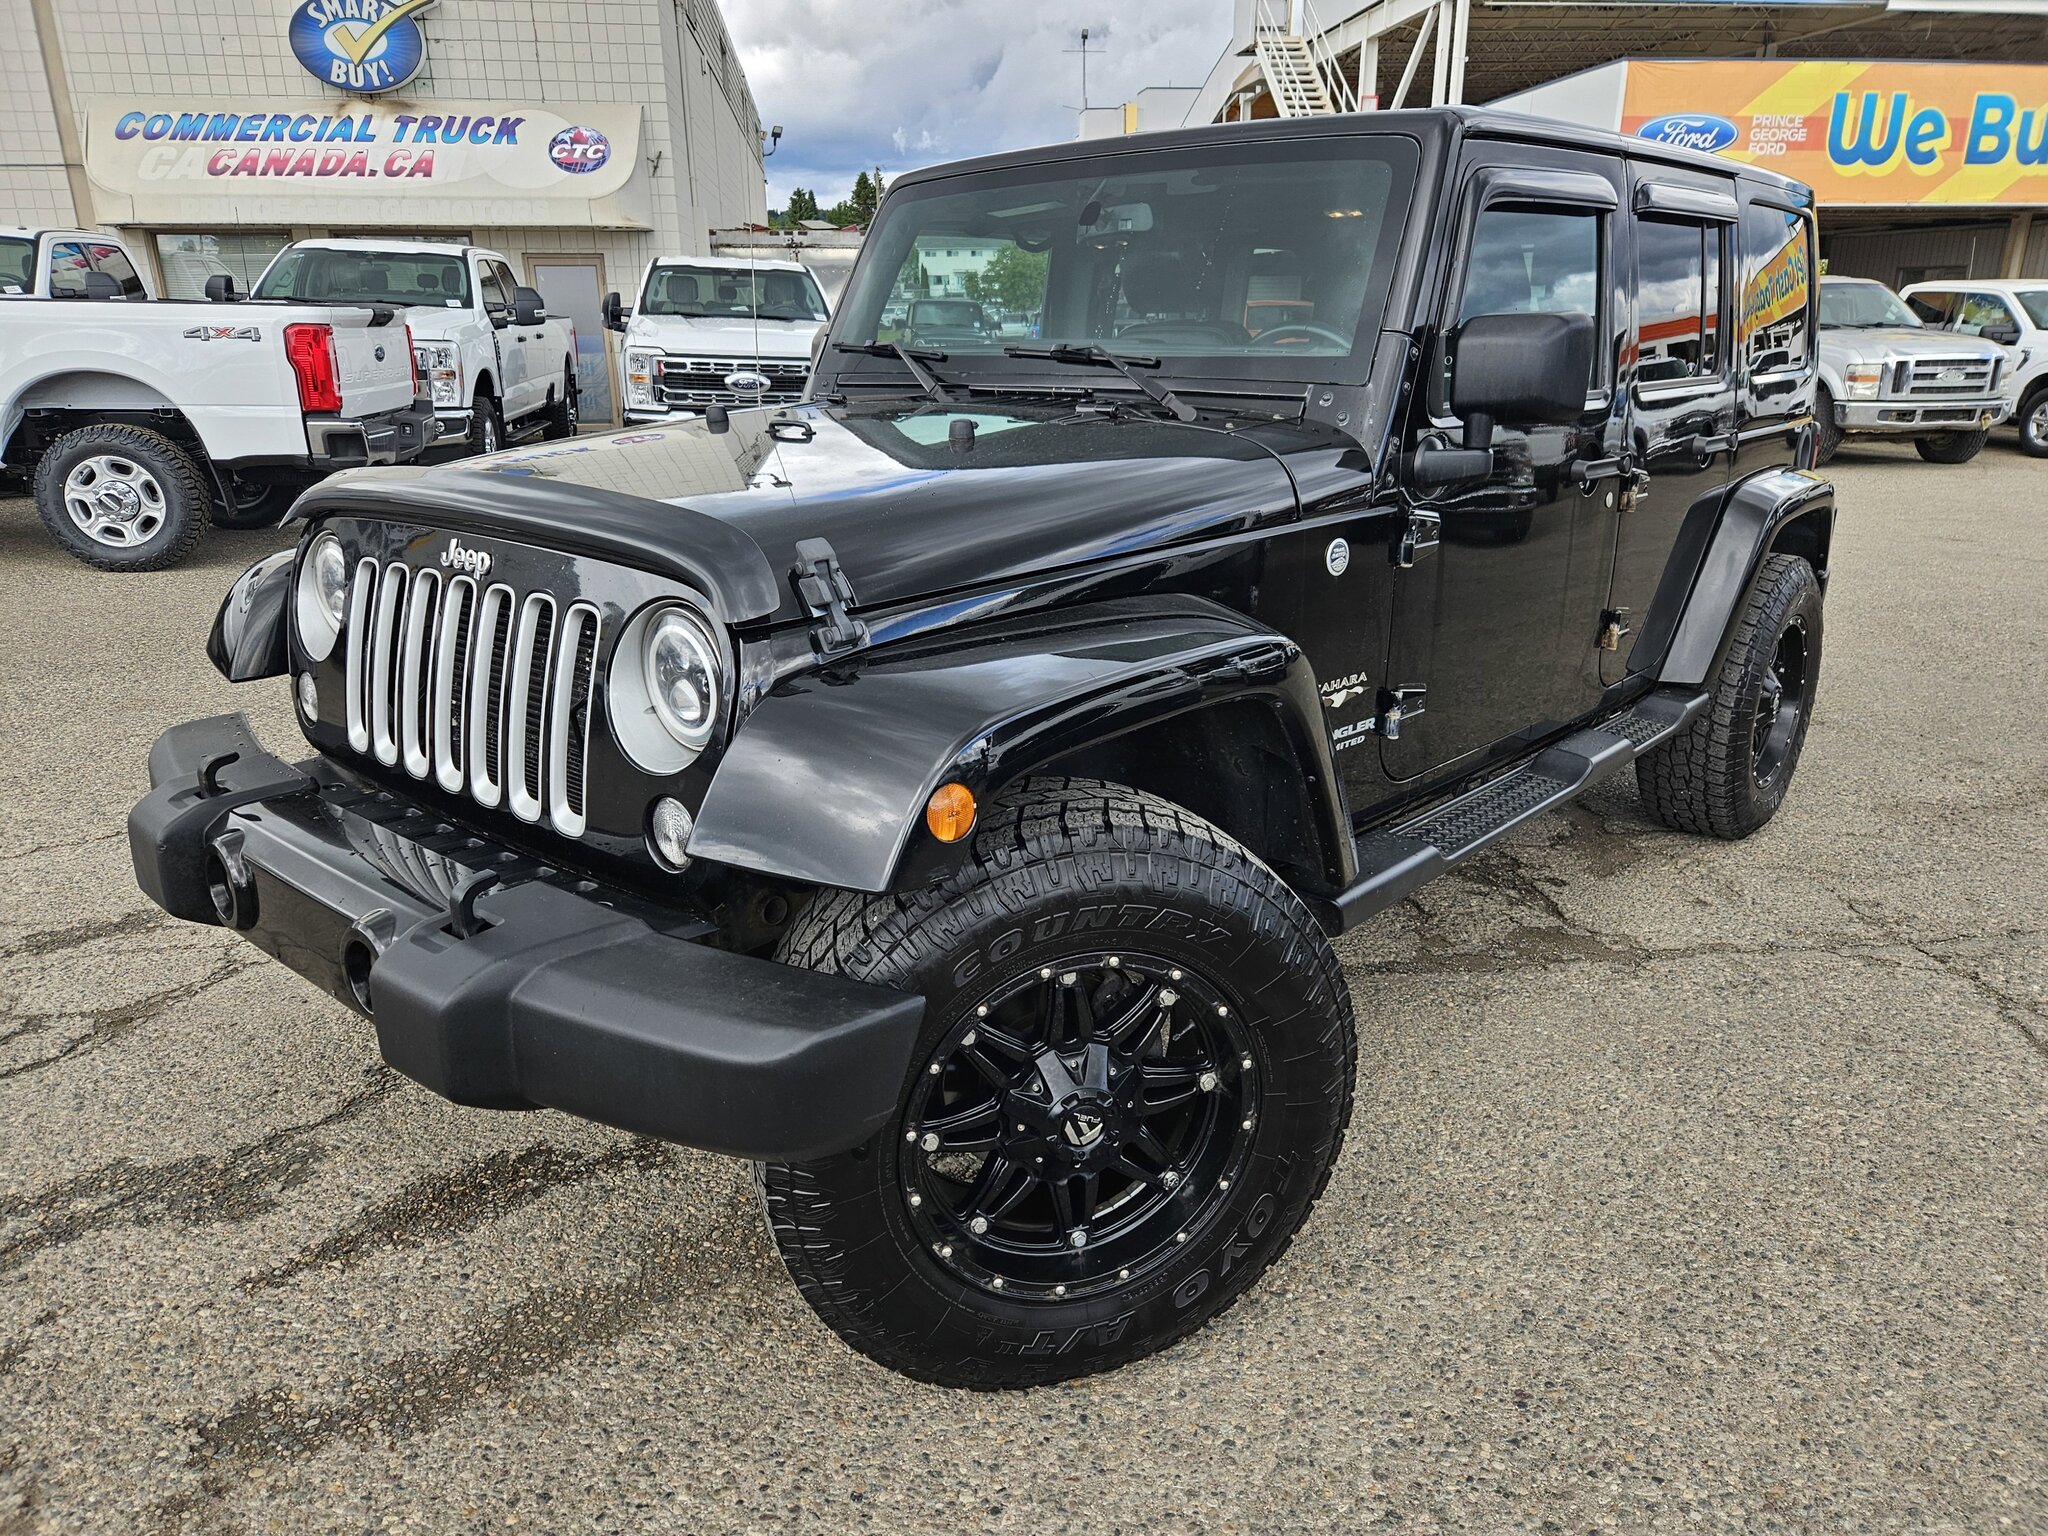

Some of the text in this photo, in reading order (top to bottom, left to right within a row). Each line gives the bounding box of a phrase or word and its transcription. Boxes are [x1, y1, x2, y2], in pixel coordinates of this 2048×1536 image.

[306, 0, 395, 29] SMART
[330, 58, 395, 88] BUY!
[114, 111, 527, 145] COMMERCIAL TRUCK
[1656, 118, 1724, 149] Ford
[1749, 128, 1808, 143] GEORGE
[1751, 114, 1805, 128] PRINCE
[1826, 91, 2048, 168] We Bu
[206, 147, 435, 178] CANADA.CA
[550, 143, 606, 160] CTC
[1747, 142, 1787, 157] FORD
[736, 378, 763, 390] Ford
[440, 538, 492, 580] Jeep
[1318, 671, 1368, 693] AHARA
[1332, 717, 1376, 740] NGLER
[951, 904, 1232, 988] COUNTRY
[1073, 1112, 1101, 1124] FUEL
[1170, 1150, 1297, 1310] TOYO
